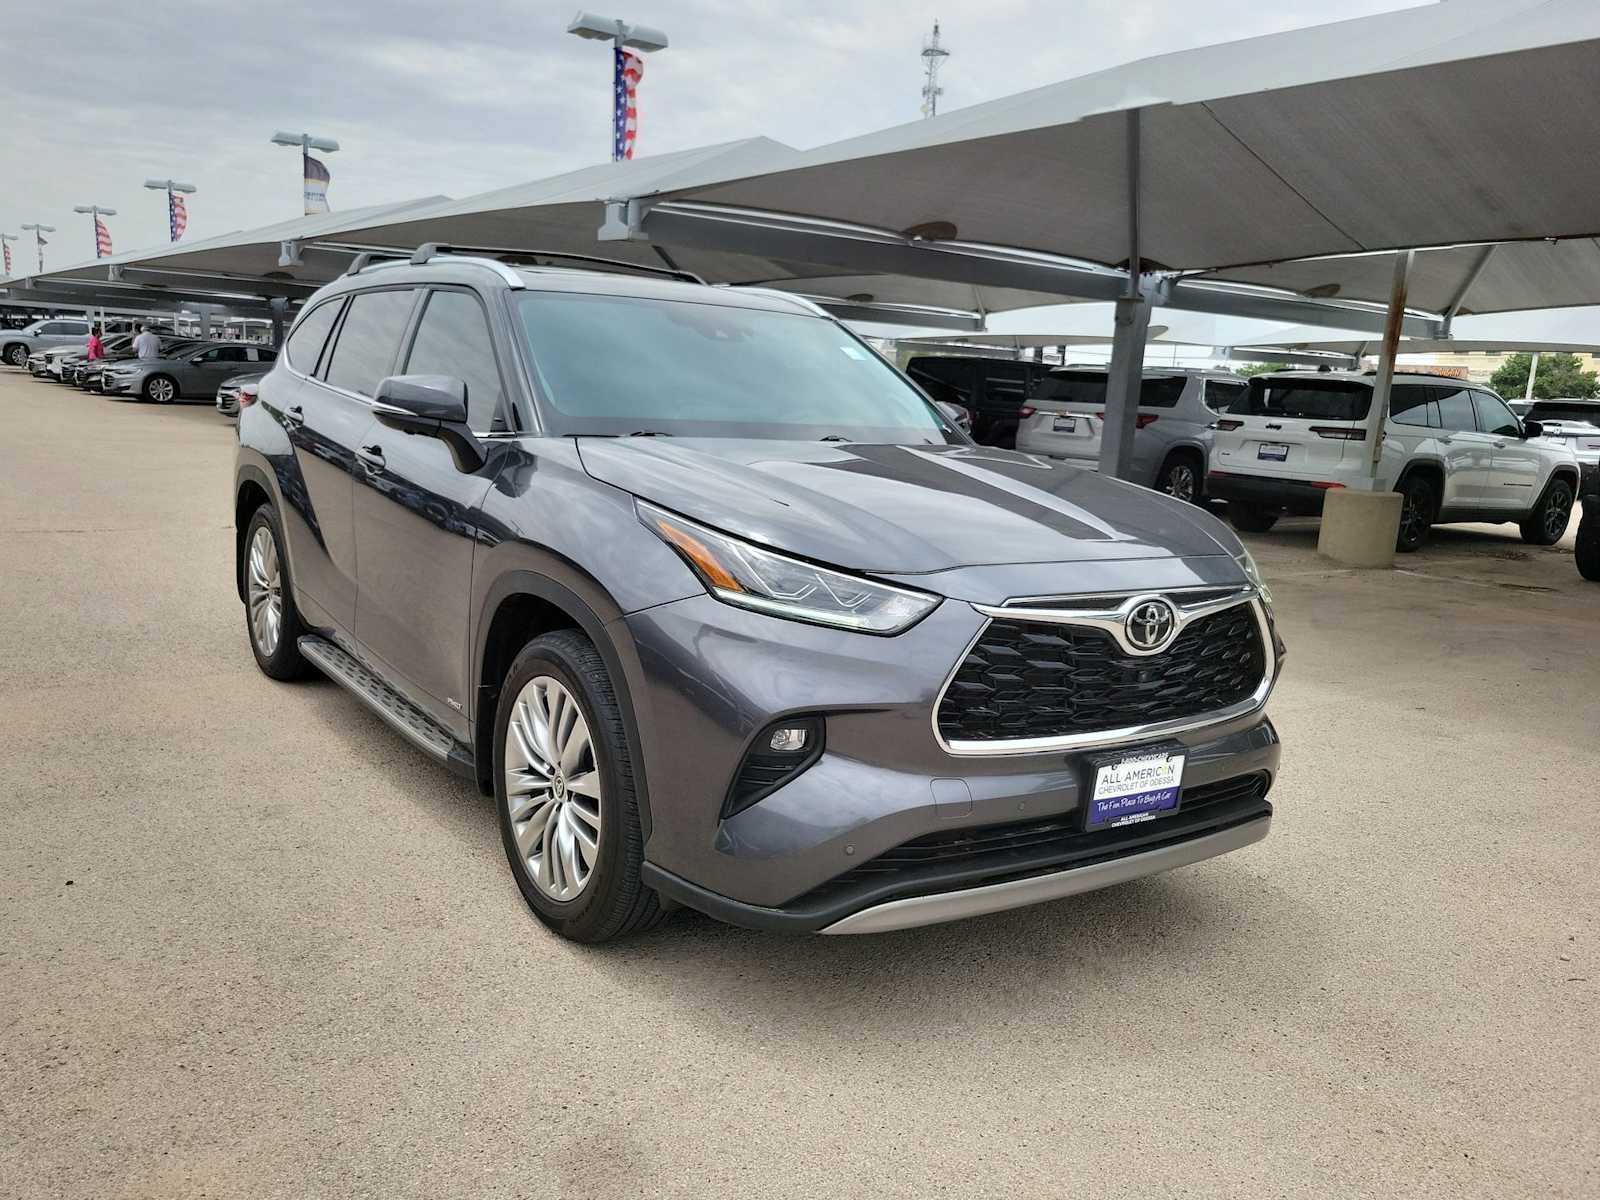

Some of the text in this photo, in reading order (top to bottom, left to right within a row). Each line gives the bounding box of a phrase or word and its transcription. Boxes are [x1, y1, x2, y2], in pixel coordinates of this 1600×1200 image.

[1098, 776, 1175, 795] CHEVROLET OF ODESSA
[1102, 773, 1121, 785] ALL
[1097, 801, 1108, 812] The
[1120, 797, 1136, 808] Place
[1137, 795, 1144, 805] To
[1144, 794, 1156, 805] Buy
[1156, 792, 1161, 801] A
[1161, 791, 1172, 800] Car
